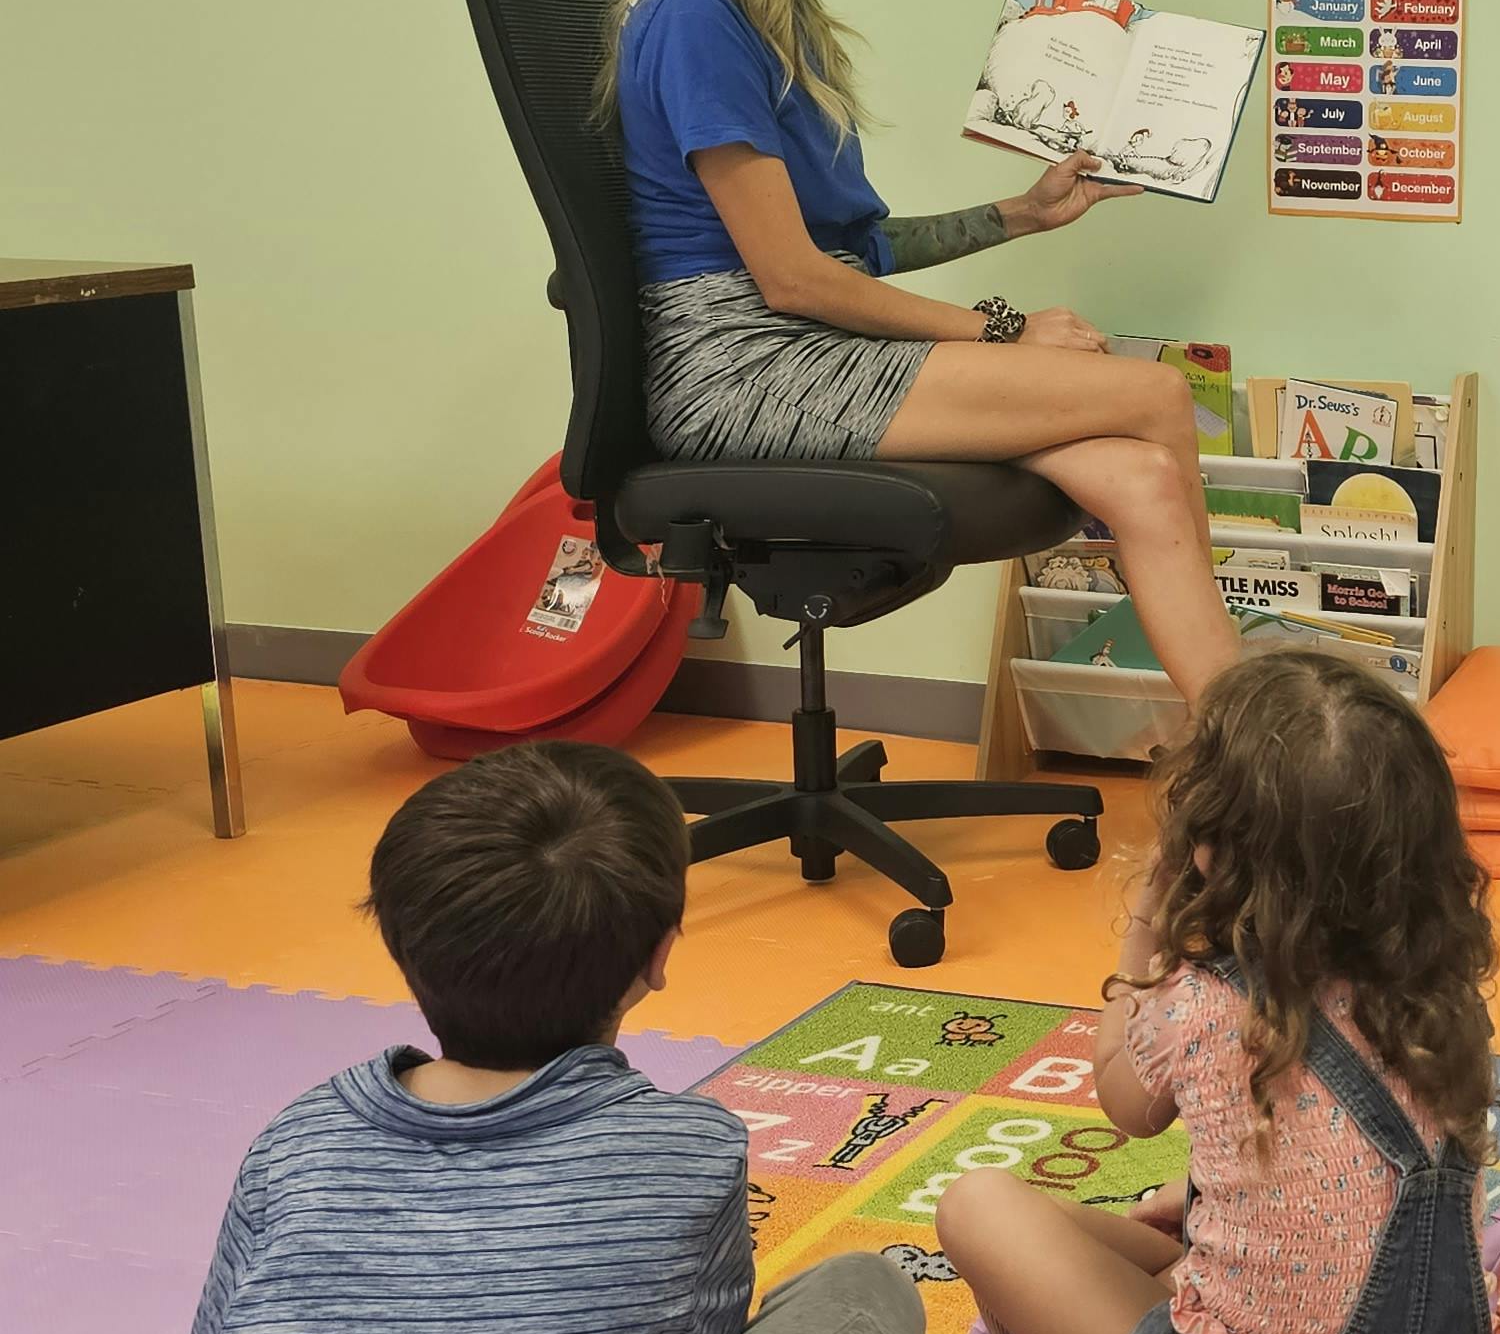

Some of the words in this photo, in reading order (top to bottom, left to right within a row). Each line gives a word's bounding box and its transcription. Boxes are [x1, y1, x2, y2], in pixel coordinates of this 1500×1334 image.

[1311, 0, 1359, 13] January
[1404, 3, 1455, 17] February
[1320, 36, 1356, 48] March
[1414, 38, 1442, 52] April
[1320, 73, 1350, 89] May
[1413, 75, 1442, 87] June
[1321, 108, 1345, 122] July
[1403, 111, 1444, 124] August
[1298, 143, 1362, 156] September
[1399, 147, 1446, 160] October
[1301, 179, 1361, 192] November
[1392, 182, 1451, 195] December
[1295, 395, 1317, 409] Dr.
[1318, 396, 1360, 416] Seuss's
[1214, 576, 1248, 593] TLE
[1254, 579, 1299, 597] MISS
[1327, 584, 1366, 597] Morris
[1367, 588, 1390, 599] Go
[1334, 595, 1347, 605] to
[1348, 596, 1388, 609] School
[868, 1001, 937, 1017] ant
[799, 1035, 883, 1071] A
[886, 1057, 932, 1077] a
[1009, 1056, 1093, 1094] B
[734, 1071, 863, 1099] zipper
[758, 1139, 815, 1162] z
